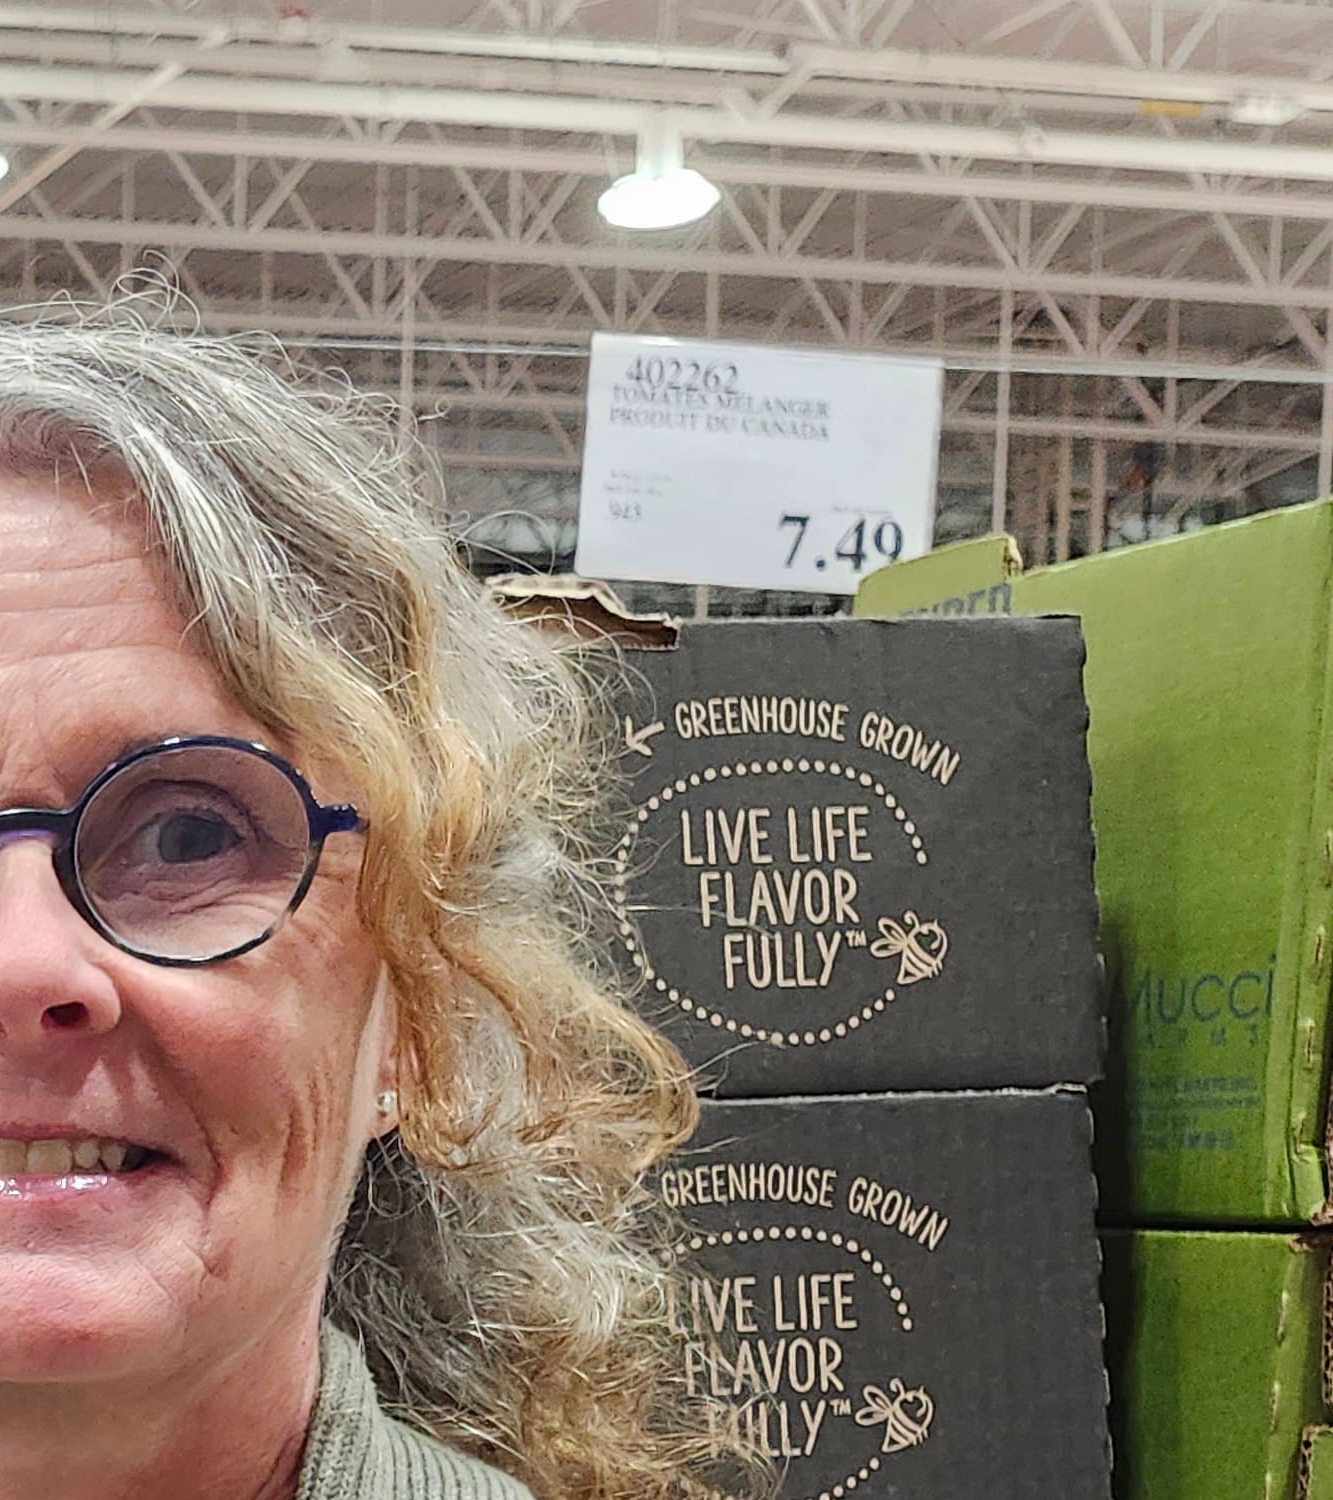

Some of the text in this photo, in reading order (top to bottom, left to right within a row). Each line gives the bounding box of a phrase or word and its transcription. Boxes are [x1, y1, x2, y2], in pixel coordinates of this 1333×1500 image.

[627, 356, 739, 395] 402262
[609, 407, 830, 442] PRODUIT DU CANADA
[779, 513, 903, 572] 7.49
[675, 697, 961, 786] GREENHOUSE GROWN
[681, 806, 872, 865] LIVE LIFE
[700, 869, 860, 927] FLAVOR
[661, 1163, 949, 1251] GREENHOUSE GROWN
[774, 1273, 858, 1331] LIFE
[685, 1337, 845, 1396] FLAVOR
